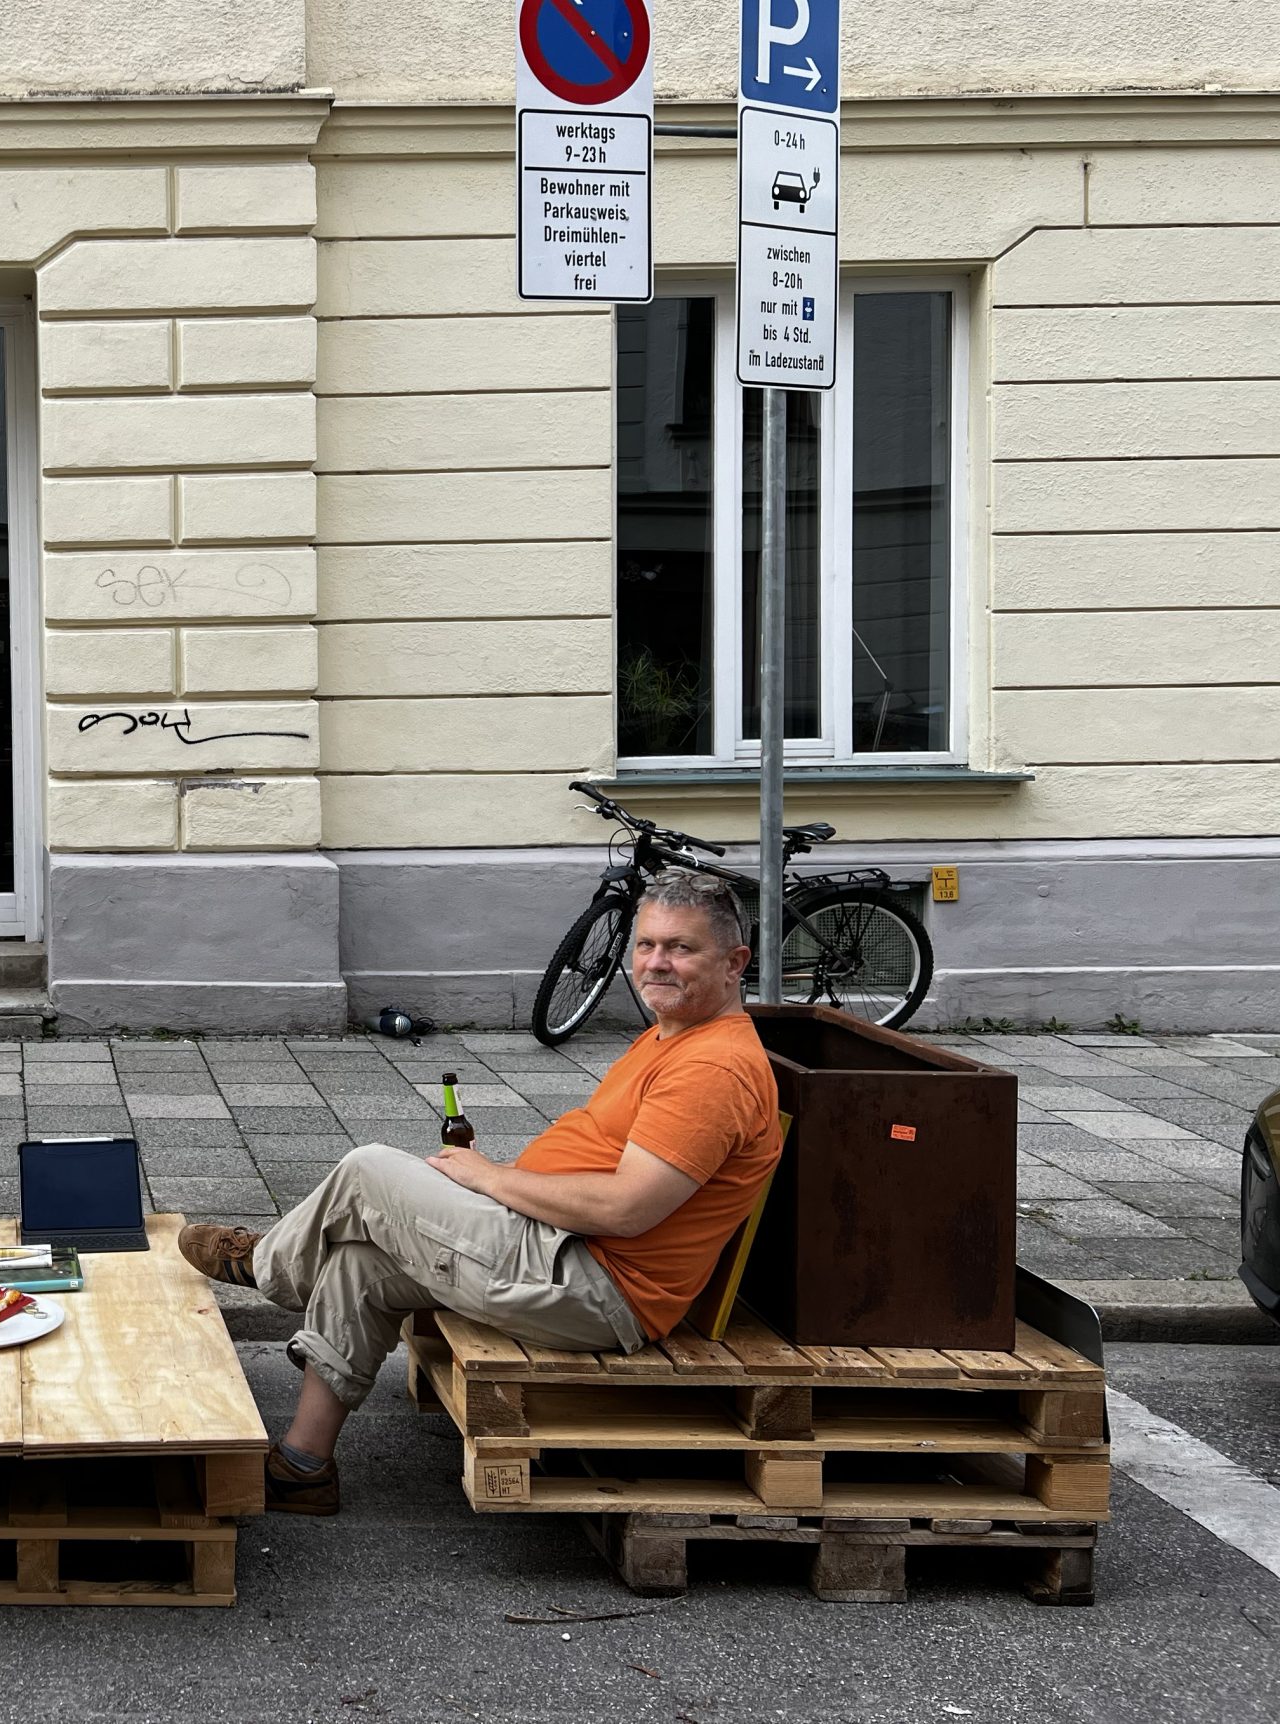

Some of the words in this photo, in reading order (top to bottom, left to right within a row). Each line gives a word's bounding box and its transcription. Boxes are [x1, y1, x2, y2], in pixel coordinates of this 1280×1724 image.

[757, 0, 810, 84] P
[556, 121, 616, 144] werktags
[540, 177, 606, 197] Bewohner
[609, 180, 631, 197] mit
[544, 225, 627, 244] Dreimühlen-
[564, 249, 607, 268] viertel
[766, 245, 811, 264] zwischen
[574, 273, 597, 291] frei
[760, 300, 778, 315] nur
[781, 299, 799, 316] mit
[763, 323, 778, 341] bis
[783, 326, 791, 342] 4
[793, 326, 813, 344] Std.
[748, 350, 762, 367] im
[765, 351, 825, 372] Ladezustand
